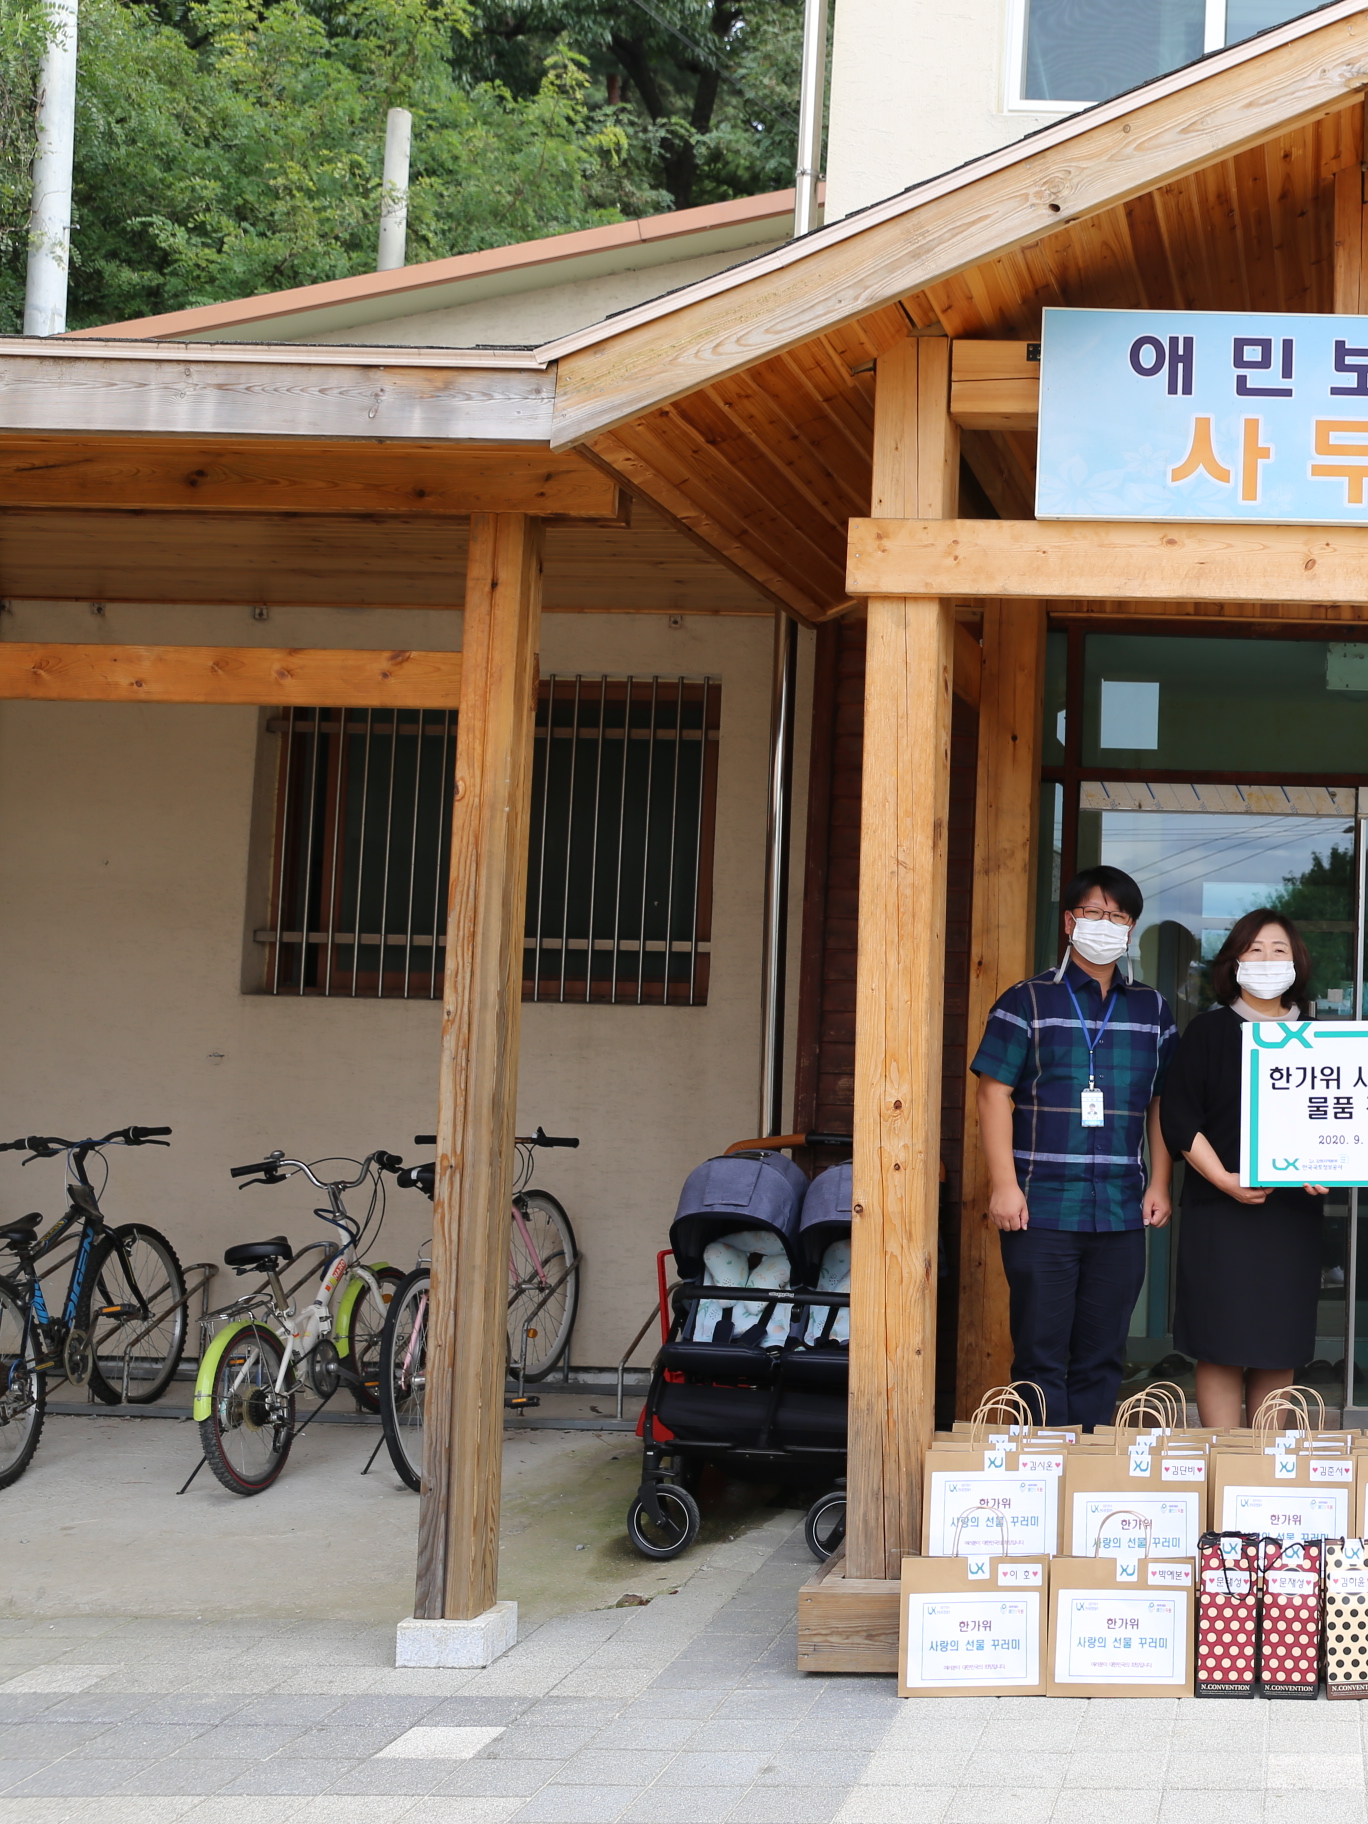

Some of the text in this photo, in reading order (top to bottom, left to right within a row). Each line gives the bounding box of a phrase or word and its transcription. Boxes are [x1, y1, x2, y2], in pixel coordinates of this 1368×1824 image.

[1269, 1066, 1341, 1090] 한가위
[1307, 1096, 1354, 1120] 물품
[1318, 1135, 1349, 1145] 2020.
[1354, 1135, 1364, 1145] 9.
[1030, 1461, 1053, 1471] 김시온
[1320, 1466, 1343, 1476] 김준서
[980, 1498, 1011, 1509] 한가위
[1011, 1516, 1038, 1527] 꾸러미
[1120, 1519, 1152, 1530] 한가위
[1270, 1514, 1302, 1526] 한가위
[1152, 1537, 1180, 1548] 꾸러미
[958, 1620, 992, 1632] 한가위
[1106, 1618, 1139, 1630] 한가위
[929, 1639, 1020, 1652] 사랑의 선물 꾸러미
[1077, 1636, 1168, 1649] 사랑의 선물 꾸러미
